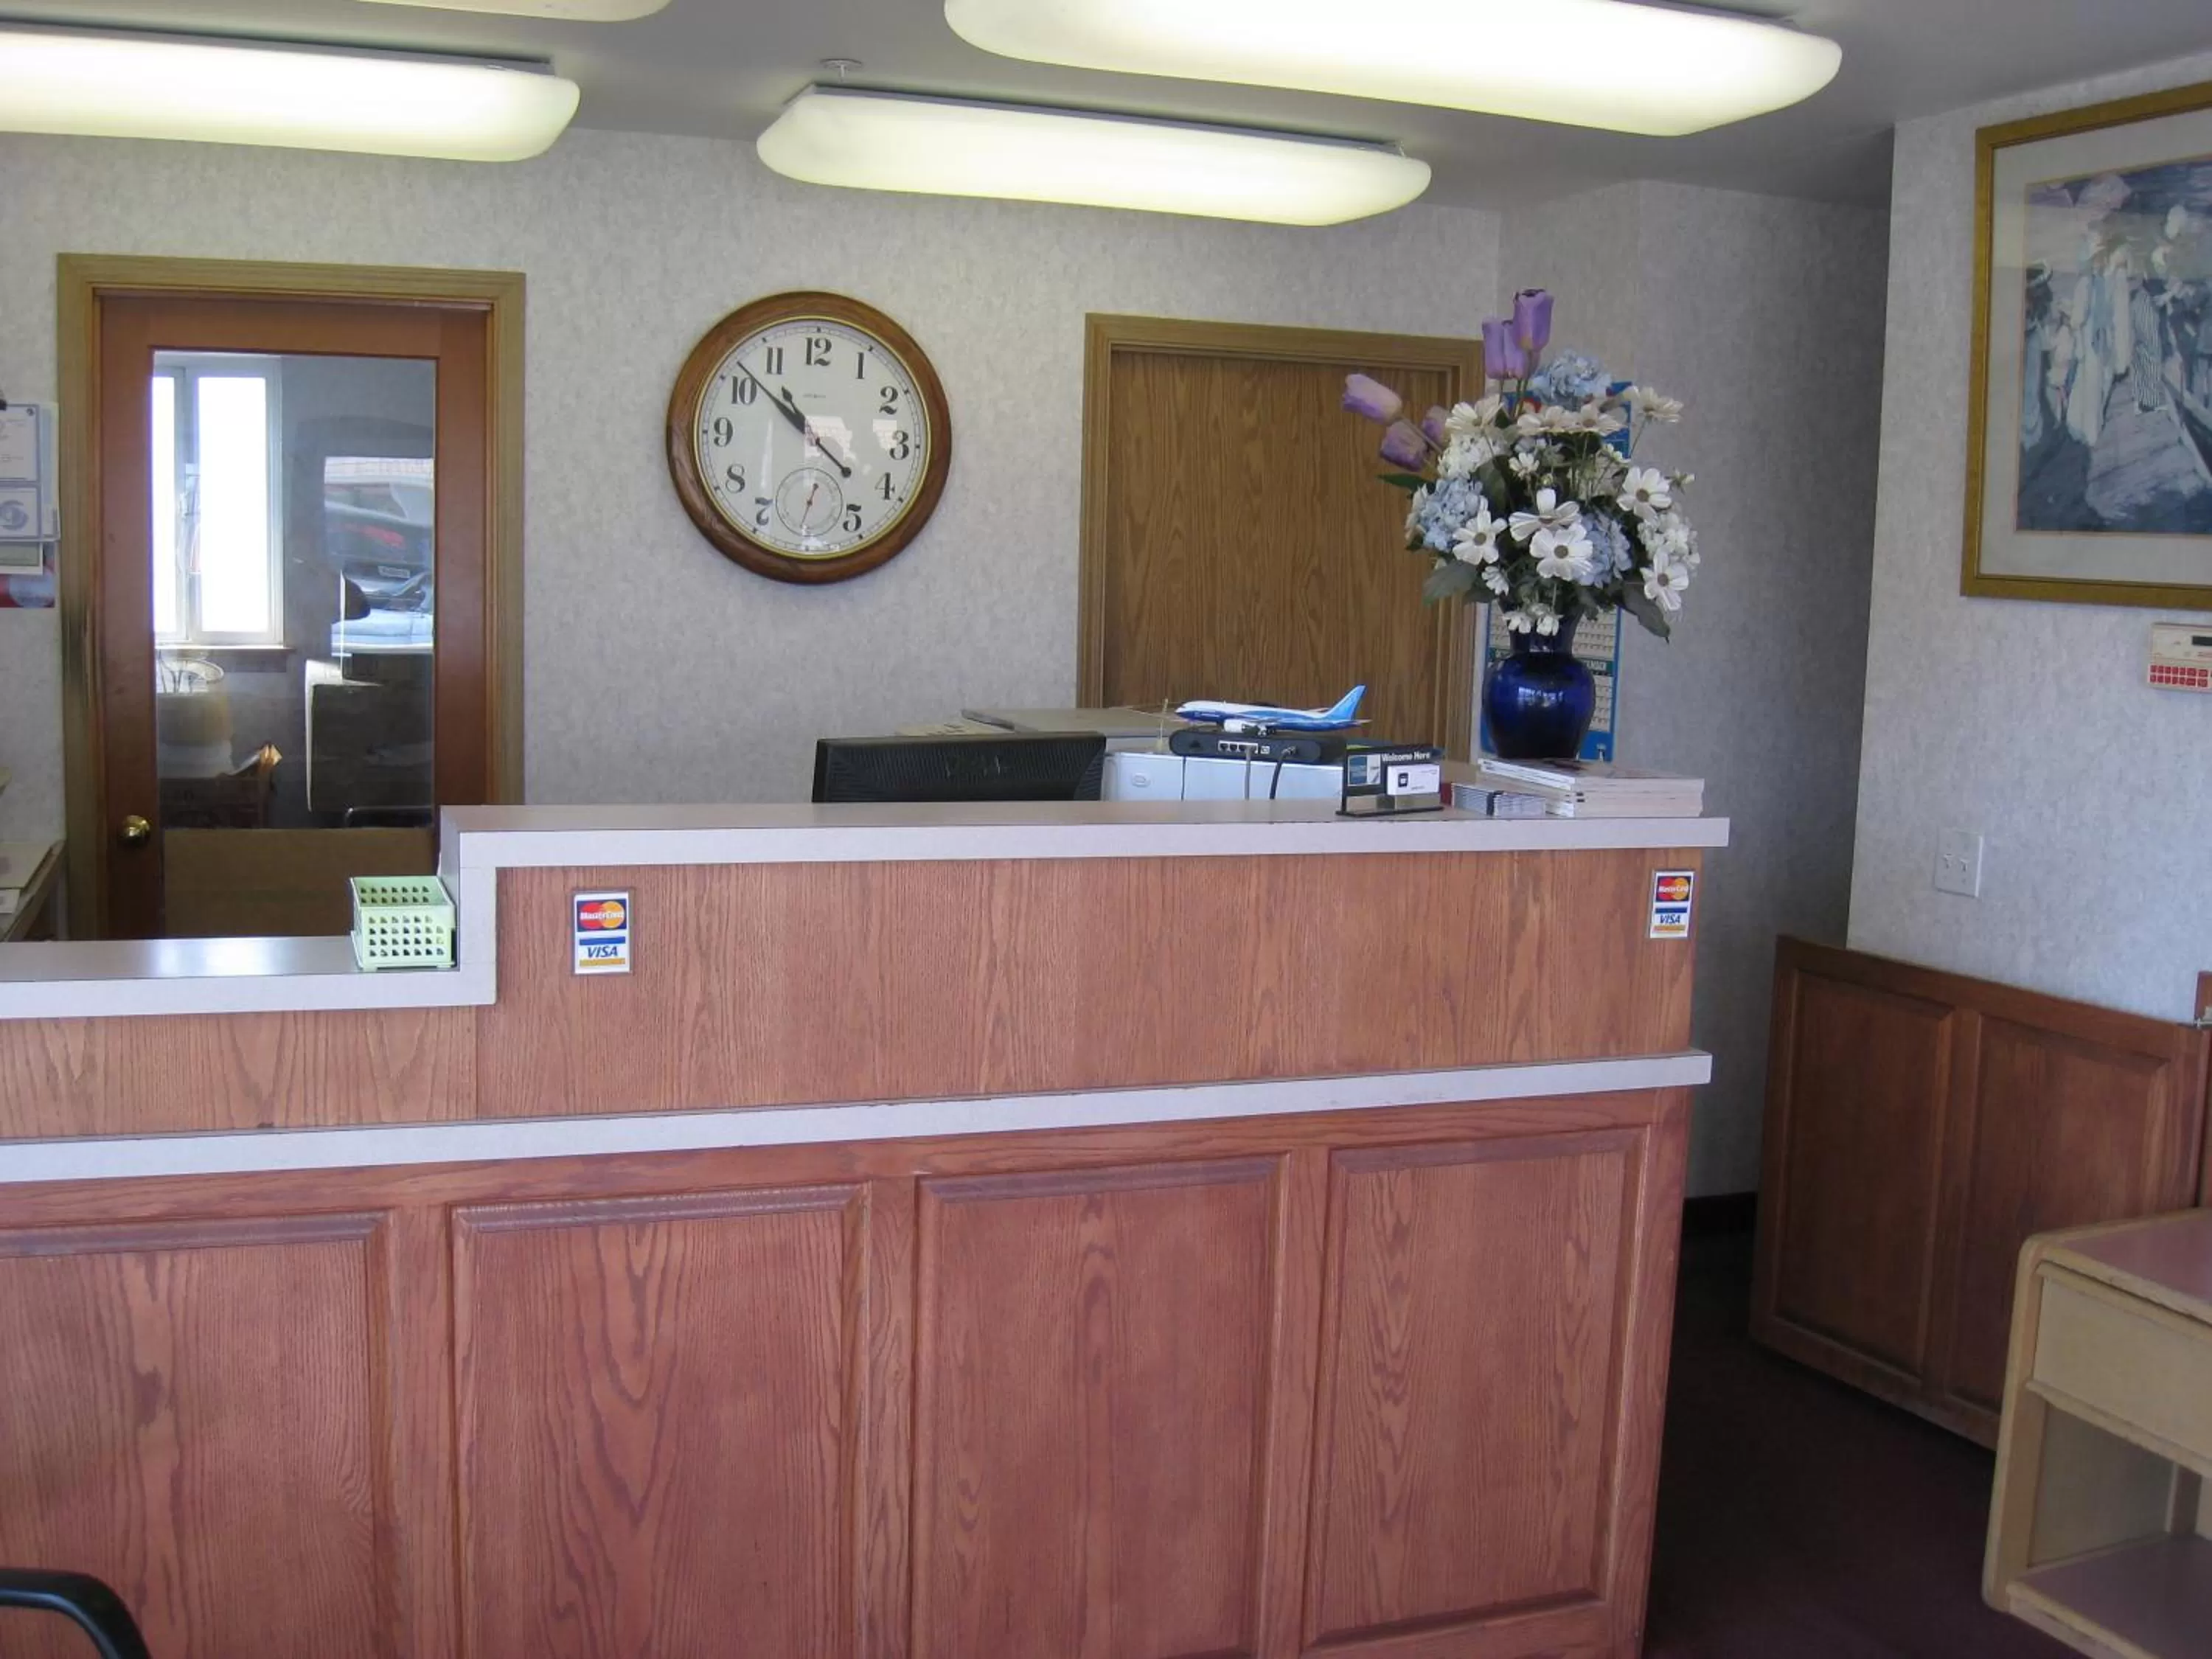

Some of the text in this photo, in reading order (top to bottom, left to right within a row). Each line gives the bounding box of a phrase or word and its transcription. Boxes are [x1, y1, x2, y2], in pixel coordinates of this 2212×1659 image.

[765, 347, 784, 375] 11
[804, 337, 832, 366] 12
[855, 352, 866, 380] 1
[731, 376, 757, 406] 10
[879, 386, 900, 415] 2
[713, 417, 734, 447] 9
[888, 430, 910, 461] 3
[725, 464, 745, 493] 8
[874, 472, 895, 501] 4
[754, 496, 773, 526] 7
[842, 503, 862, 532] 5
[1381, 751, 1431, 762] Welcome Here
[1660, 914, 1681, 924] VISA
[587, 945, 619, 959] VISA
